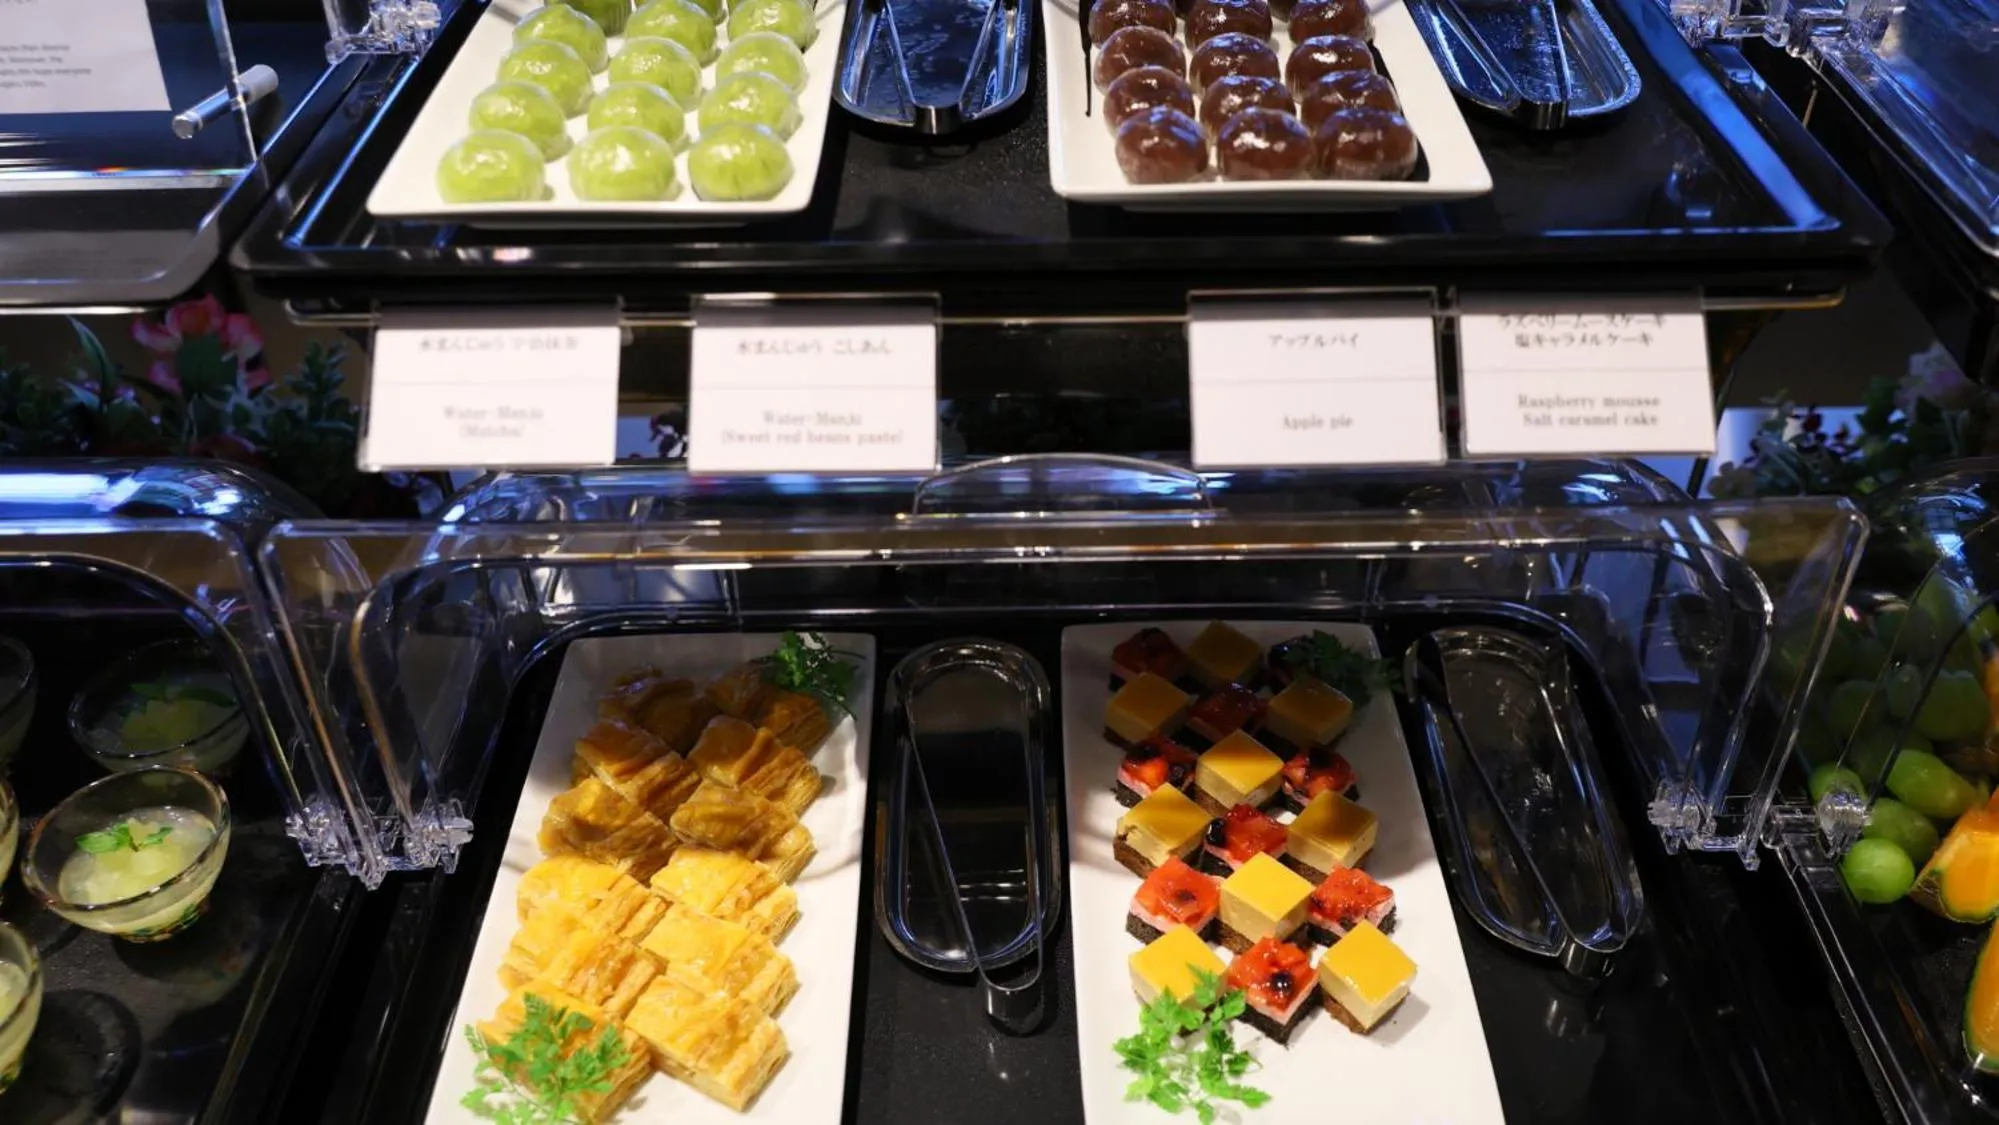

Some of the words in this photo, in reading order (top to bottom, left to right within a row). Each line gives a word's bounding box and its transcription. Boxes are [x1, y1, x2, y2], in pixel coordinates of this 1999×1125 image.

[738, 339, 823, 355] 水まんじゅう
[832, 337, 892, 355] こしあん
[1268, 332, 1359, 348] アップルパイ
[1514, 332, 1654, 349] 塩キャラメルケーキ
[1517, 393, 1596, 410] Raspberry
[1602, 397, 1661, 409] mousse
[1283, 413, 1325, 431] Apple
[1329, 414, 1354, 431] pie
[1522, 411, 1554, 427] Salt
[1559, 412, 1618, 427] caramel
[1624, 411, 1660, 427] cake
[775, 429, 802, 444] red
[806, 429, 852, 445] beans
